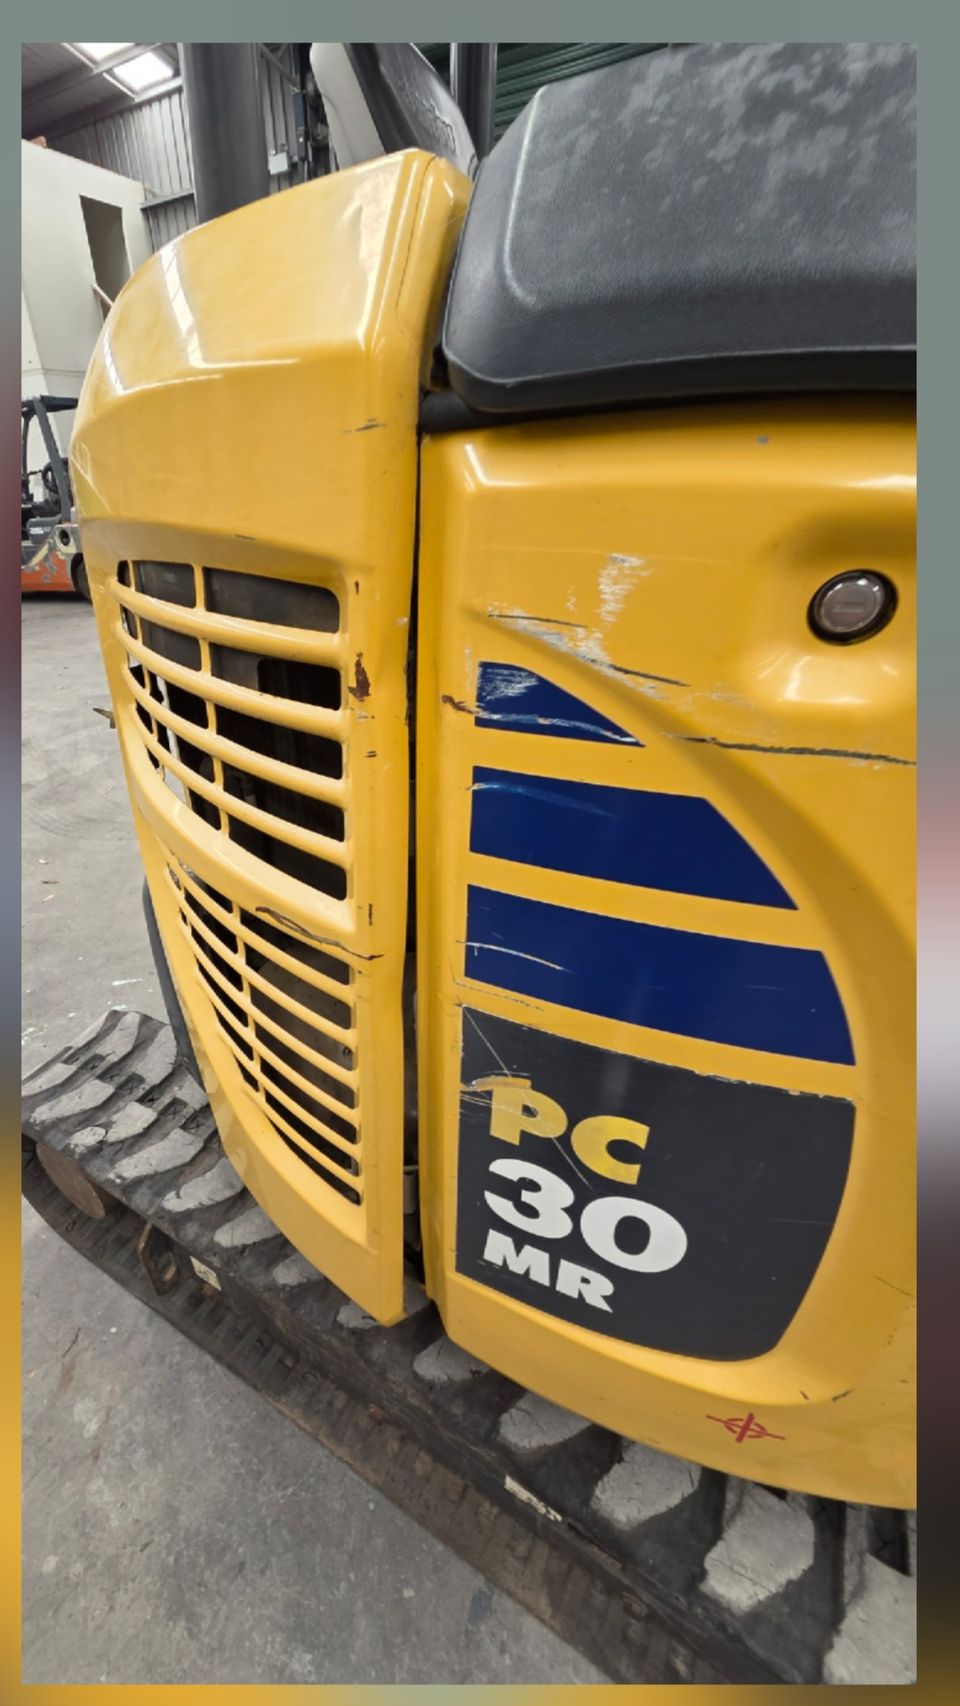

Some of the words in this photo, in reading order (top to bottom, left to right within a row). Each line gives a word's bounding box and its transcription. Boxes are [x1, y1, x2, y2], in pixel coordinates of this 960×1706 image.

[490, 1080, 650, 1185] PC
[483, 1158, 688, 1273] 30
[483, 1228, 615, 1313] MR
